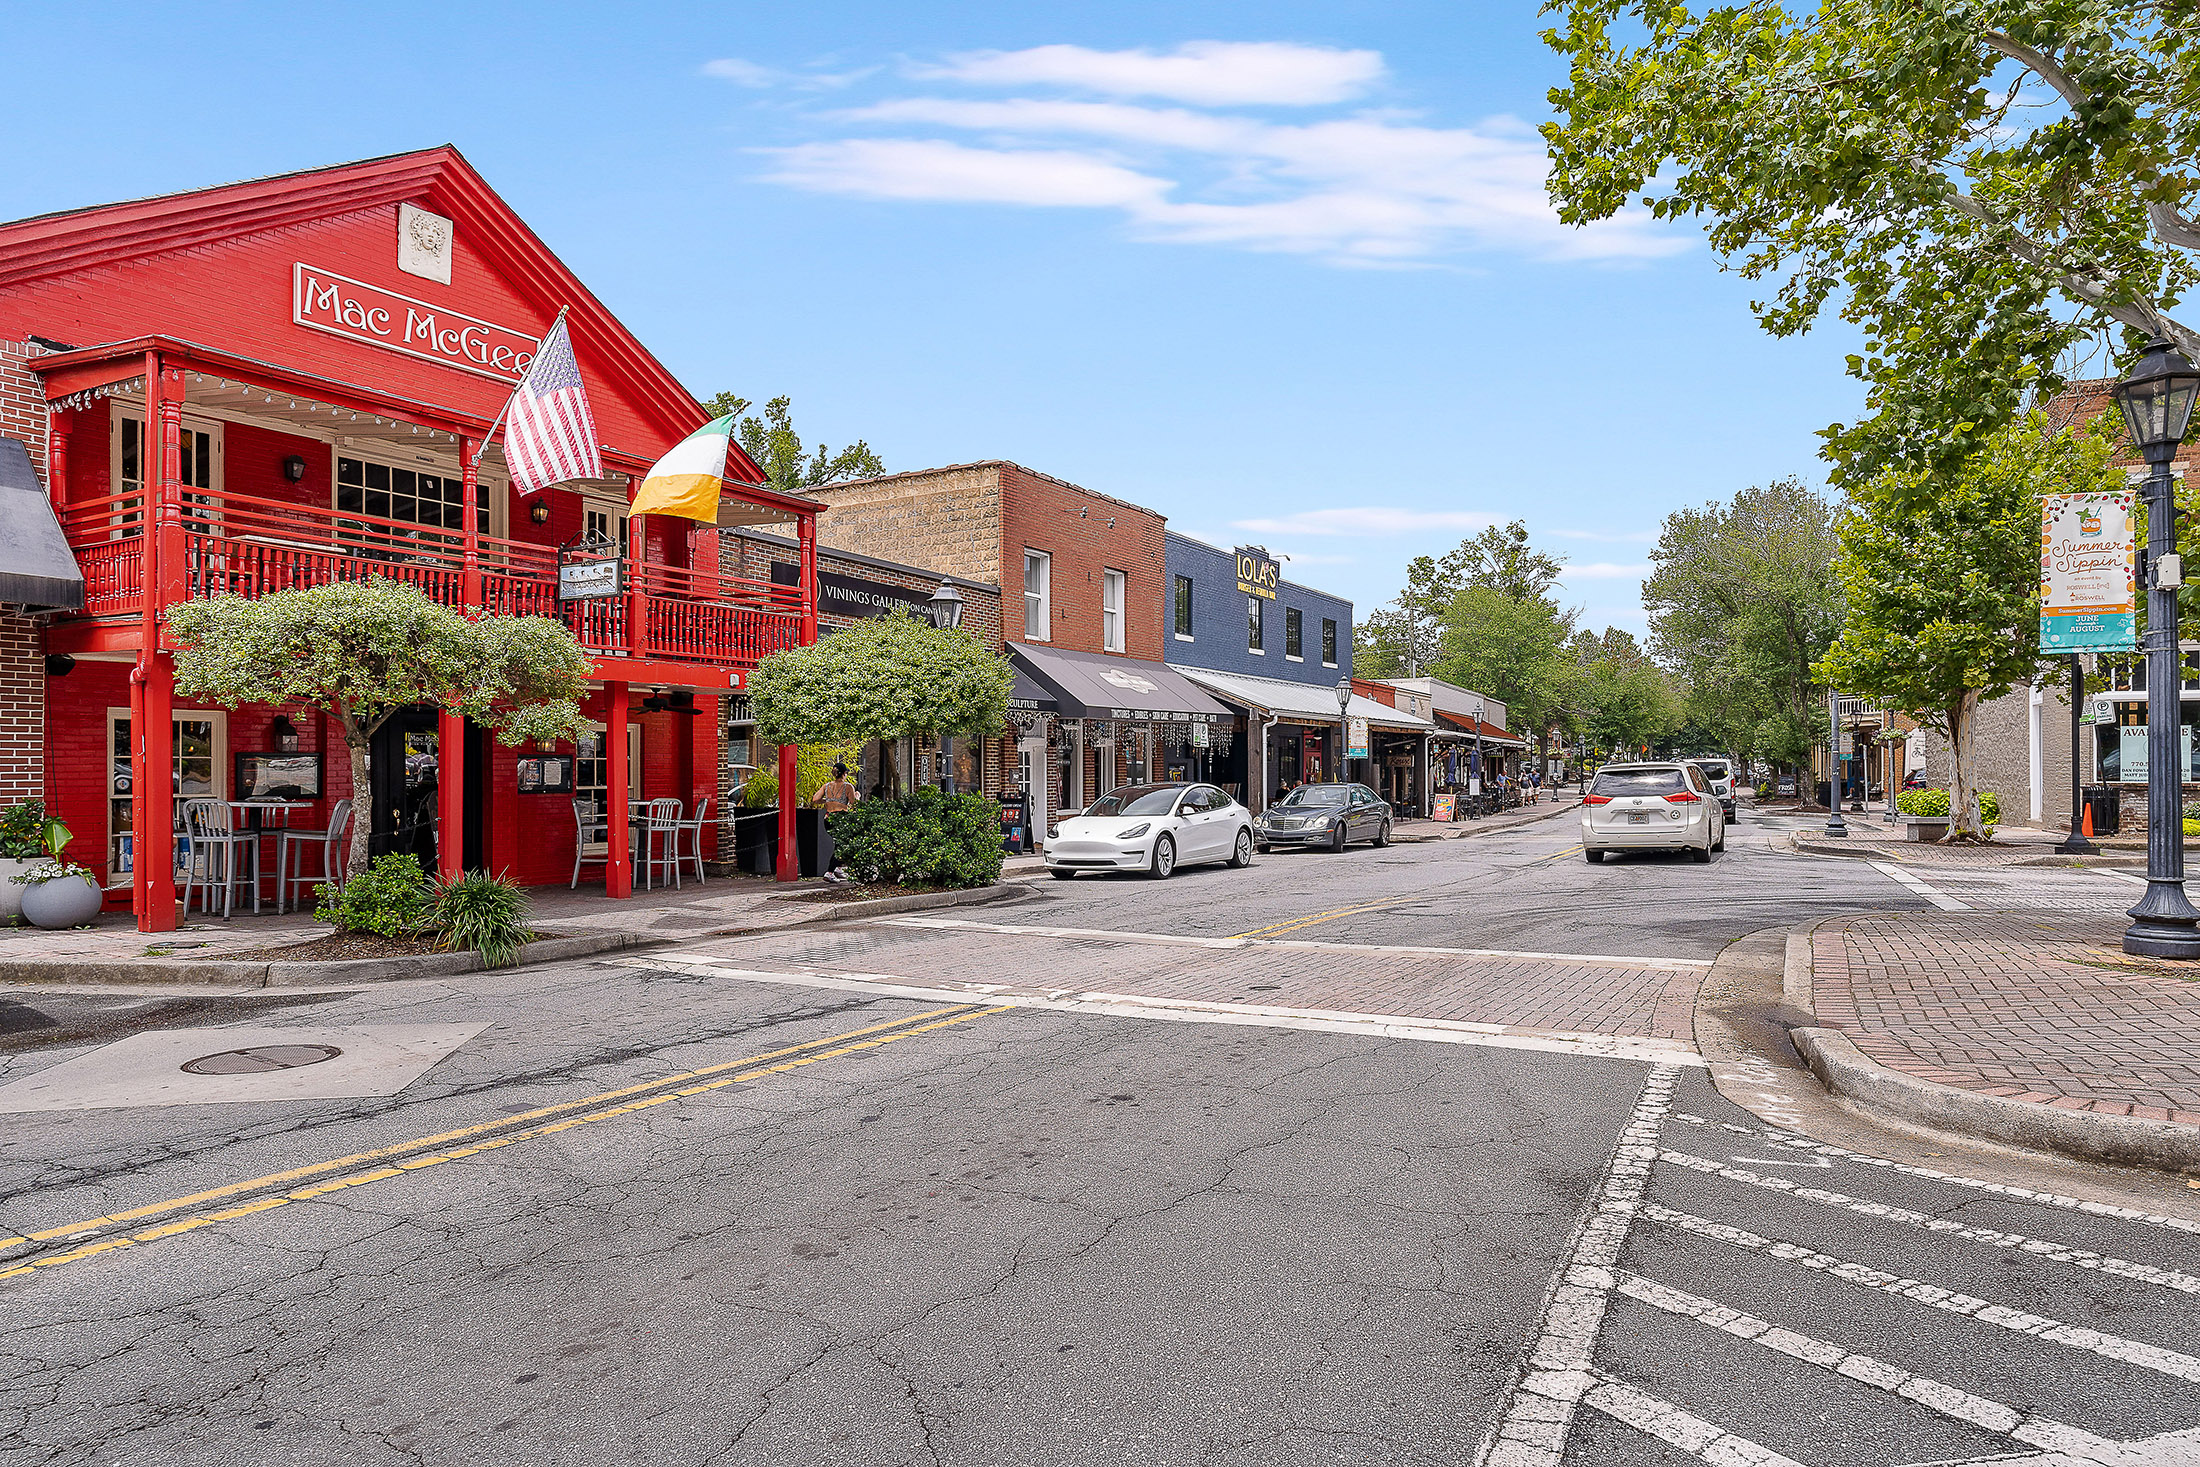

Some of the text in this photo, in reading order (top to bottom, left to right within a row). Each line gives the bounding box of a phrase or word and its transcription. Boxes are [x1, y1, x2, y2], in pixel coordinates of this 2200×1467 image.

[302, 276, 534, 376] Mac McGee
[2052, 538, 2124, 558] Summer
[2056, 553, 2123, 573] Sippin'
[826, 585, 870, 605] VININGS
[872, 594, 910, 613] GALLERY
[910, 604, 920, 612] ON
